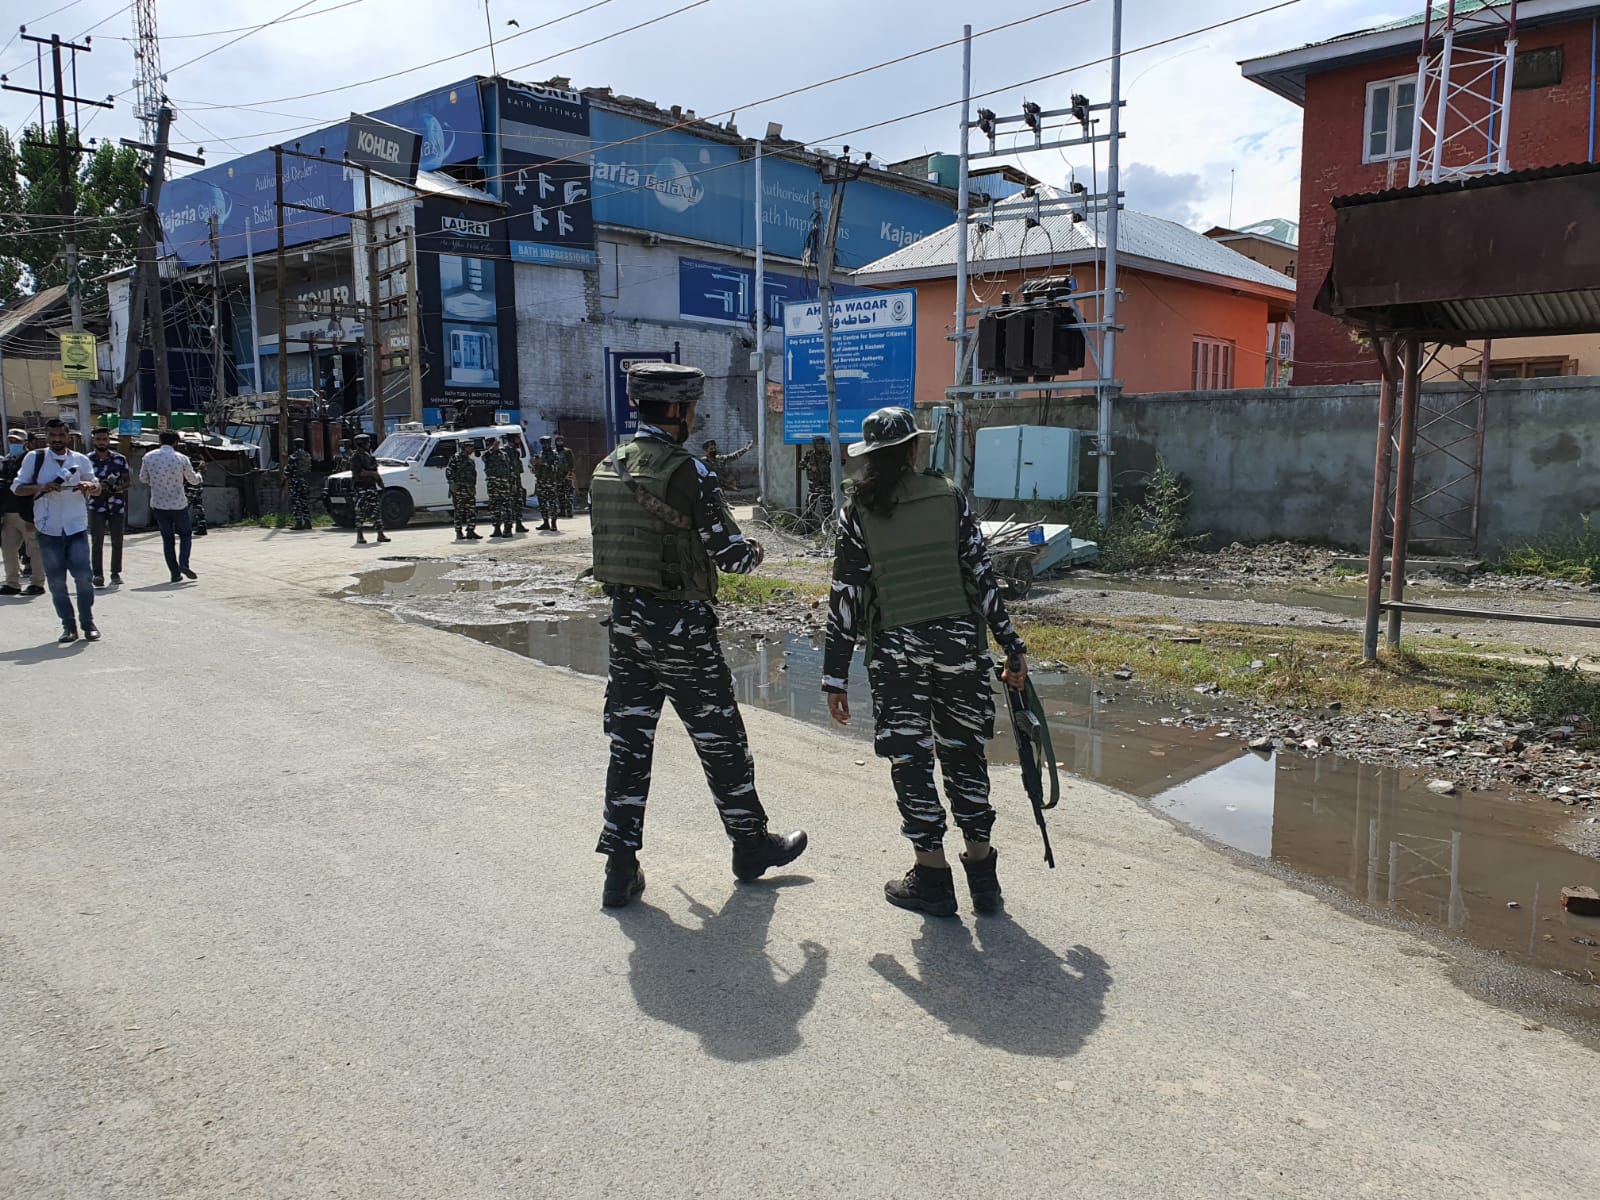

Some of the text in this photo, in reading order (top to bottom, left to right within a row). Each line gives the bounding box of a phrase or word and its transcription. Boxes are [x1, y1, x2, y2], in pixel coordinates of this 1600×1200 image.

[357, 130, 400, 163] KOHLER
[645, 174, 699, 204] Galaxy
[253, 199, 274, 225] Bath
[758, 204, 781, 226] ath
[443, 217, 488, 236] LAURET
[880, 221, 927, 248] Kajari
[518, 245, 538, 257] BATH
[806, 299, 888, 317] AHTA WAQAR
